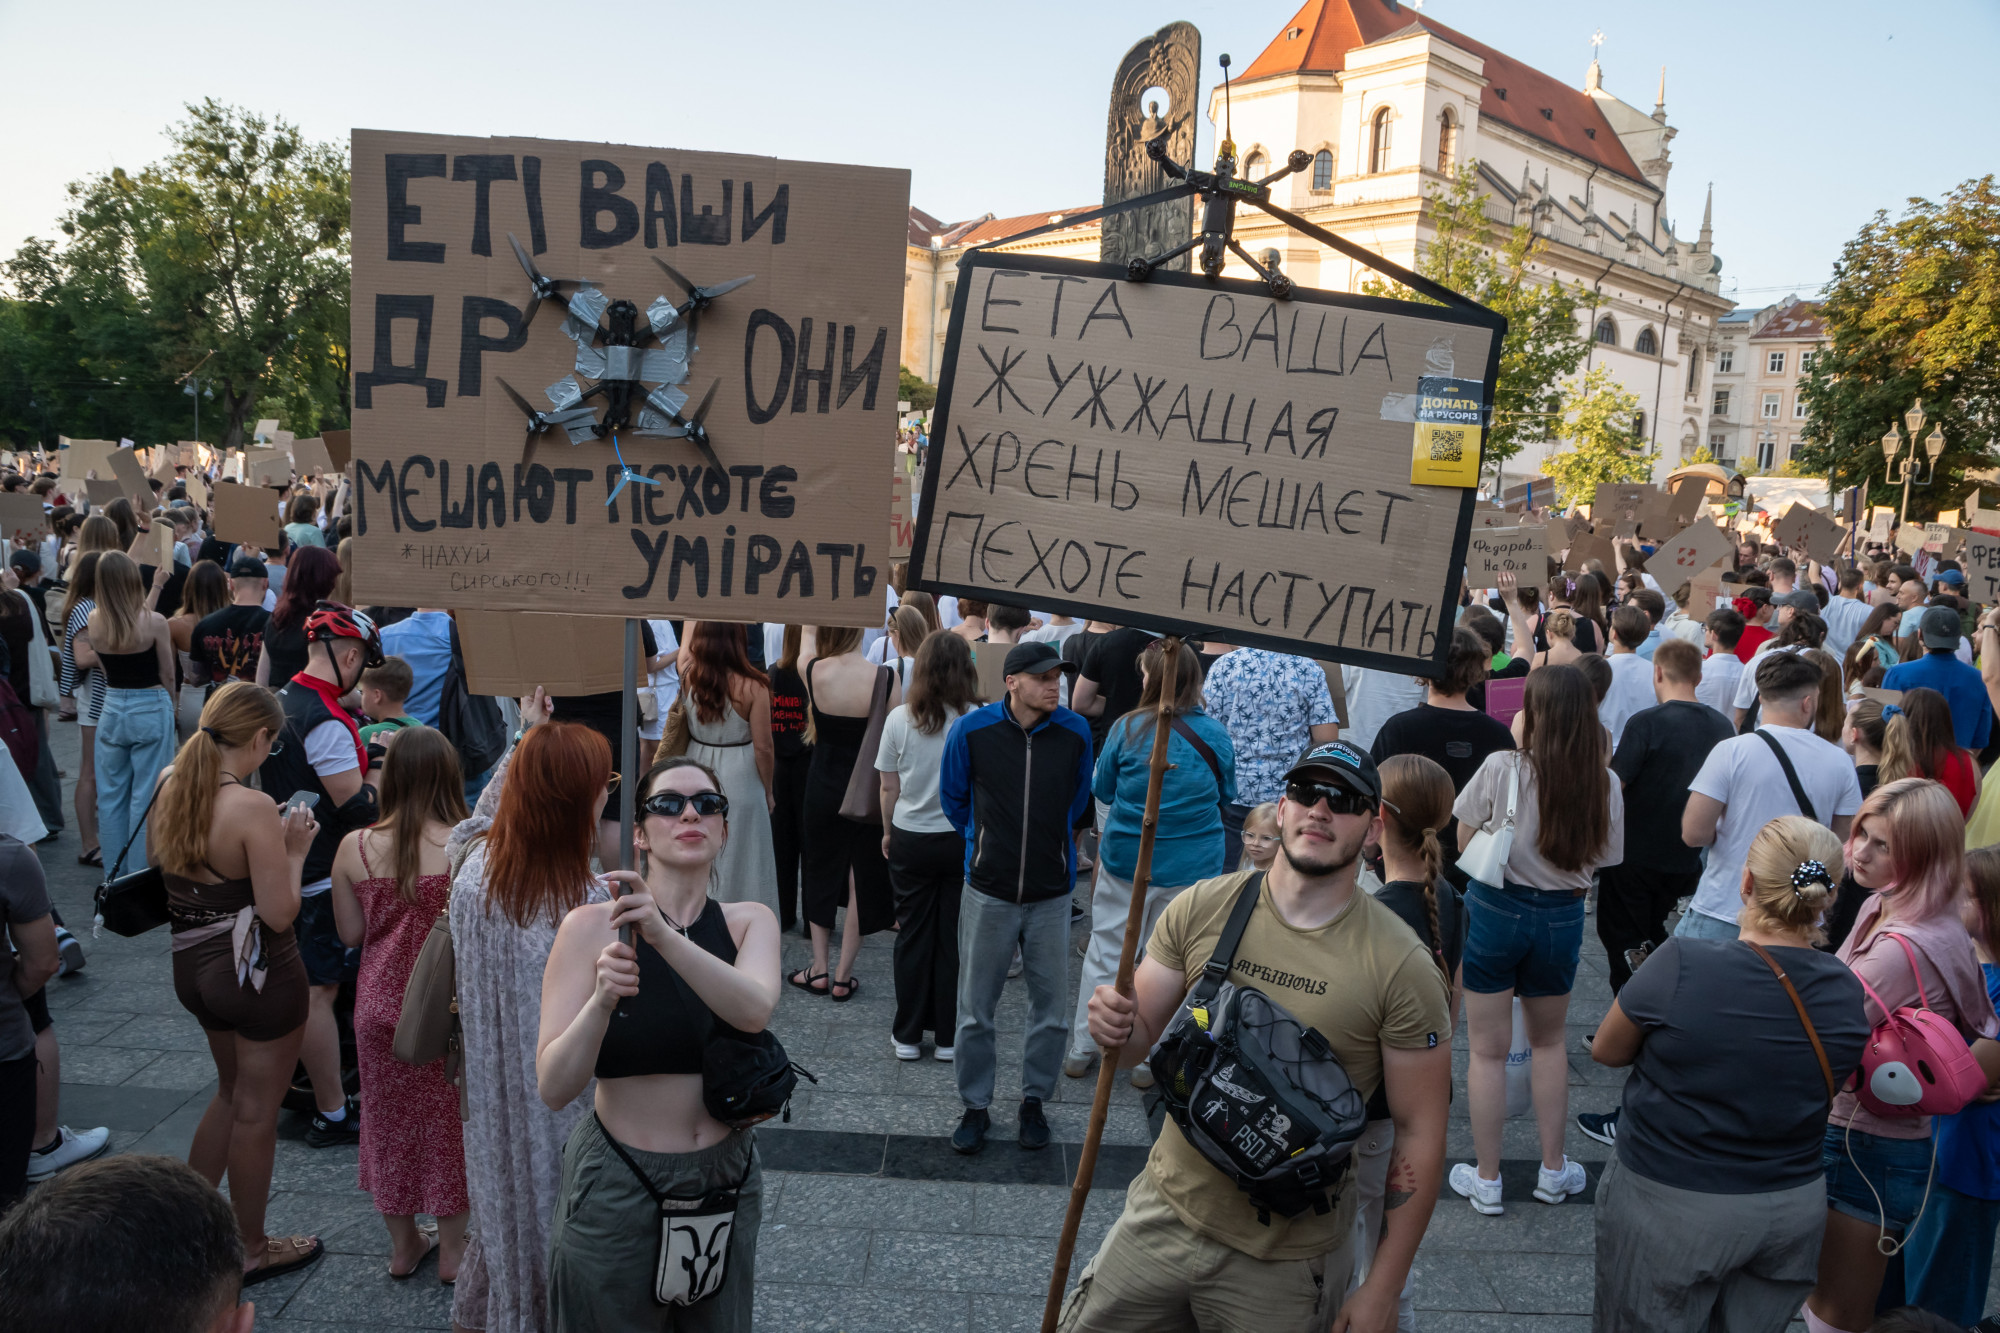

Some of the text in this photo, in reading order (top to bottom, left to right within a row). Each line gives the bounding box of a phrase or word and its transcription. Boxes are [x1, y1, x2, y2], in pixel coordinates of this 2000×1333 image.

[580, 160, 790, 249] ВАШИ
[982, 269, 1393, 382] ЕТА ВАША
[972, 343, 1340, 460] ЖУЖЖАЩАЯ
[1420, 410, 1478, 421] НА РУСОРІЗ
[1421, 397, 1478, 410] ДОНАТЬ
[1484, 559, 1499, 571] На
[1181, 556, 1436, 659] НАСТУПАТЬ
[1233, 959, 1328, 995] MPHIBIOUS
[1231, 1123, 1267, 1159] PSD
